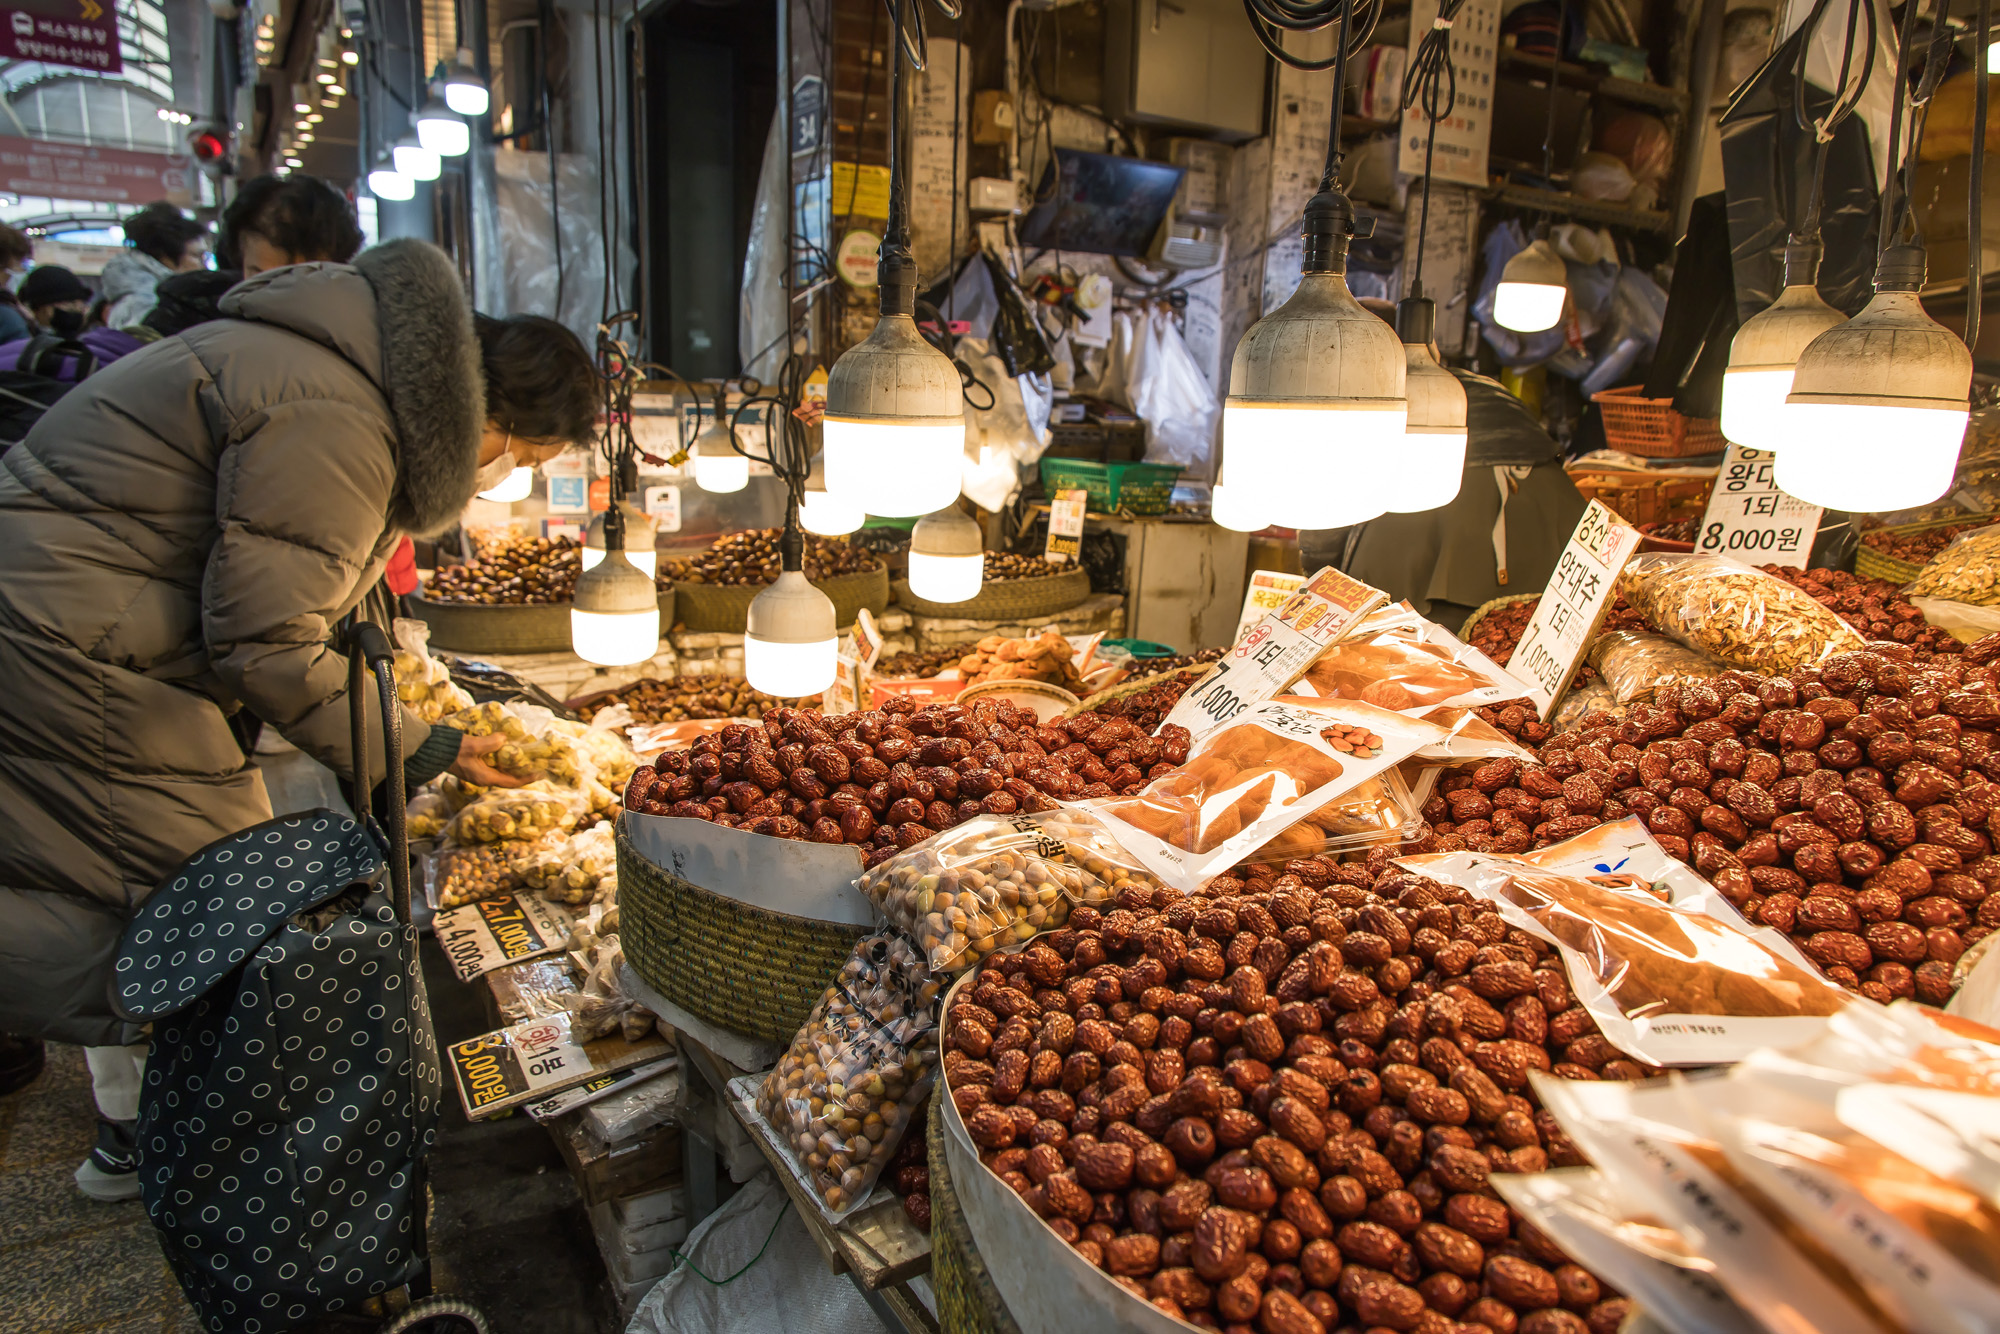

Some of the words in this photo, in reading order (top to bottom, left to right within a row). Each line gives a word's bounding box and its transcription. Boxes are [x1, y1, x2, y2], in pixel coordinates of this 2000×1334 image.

[798, 113, 816, 145] 34
[1579, 506, 1609, 552] 경산
[1743, 494, 1780, 518] 1되
[1702, 522, 1803, 553] 8,000원
[1557, 551, 1601, 611] 약대추
[1549, 602, 1572, 640] 1되
[1252, 640, 1287, 671] 1되
[1520, 623, 1565, 697] 7,000원
[443, 929, 485, 979] 4,000원
[489, 909, 532, 959] 7,000원
[458, 1036, 510, 1106] 3,000원
